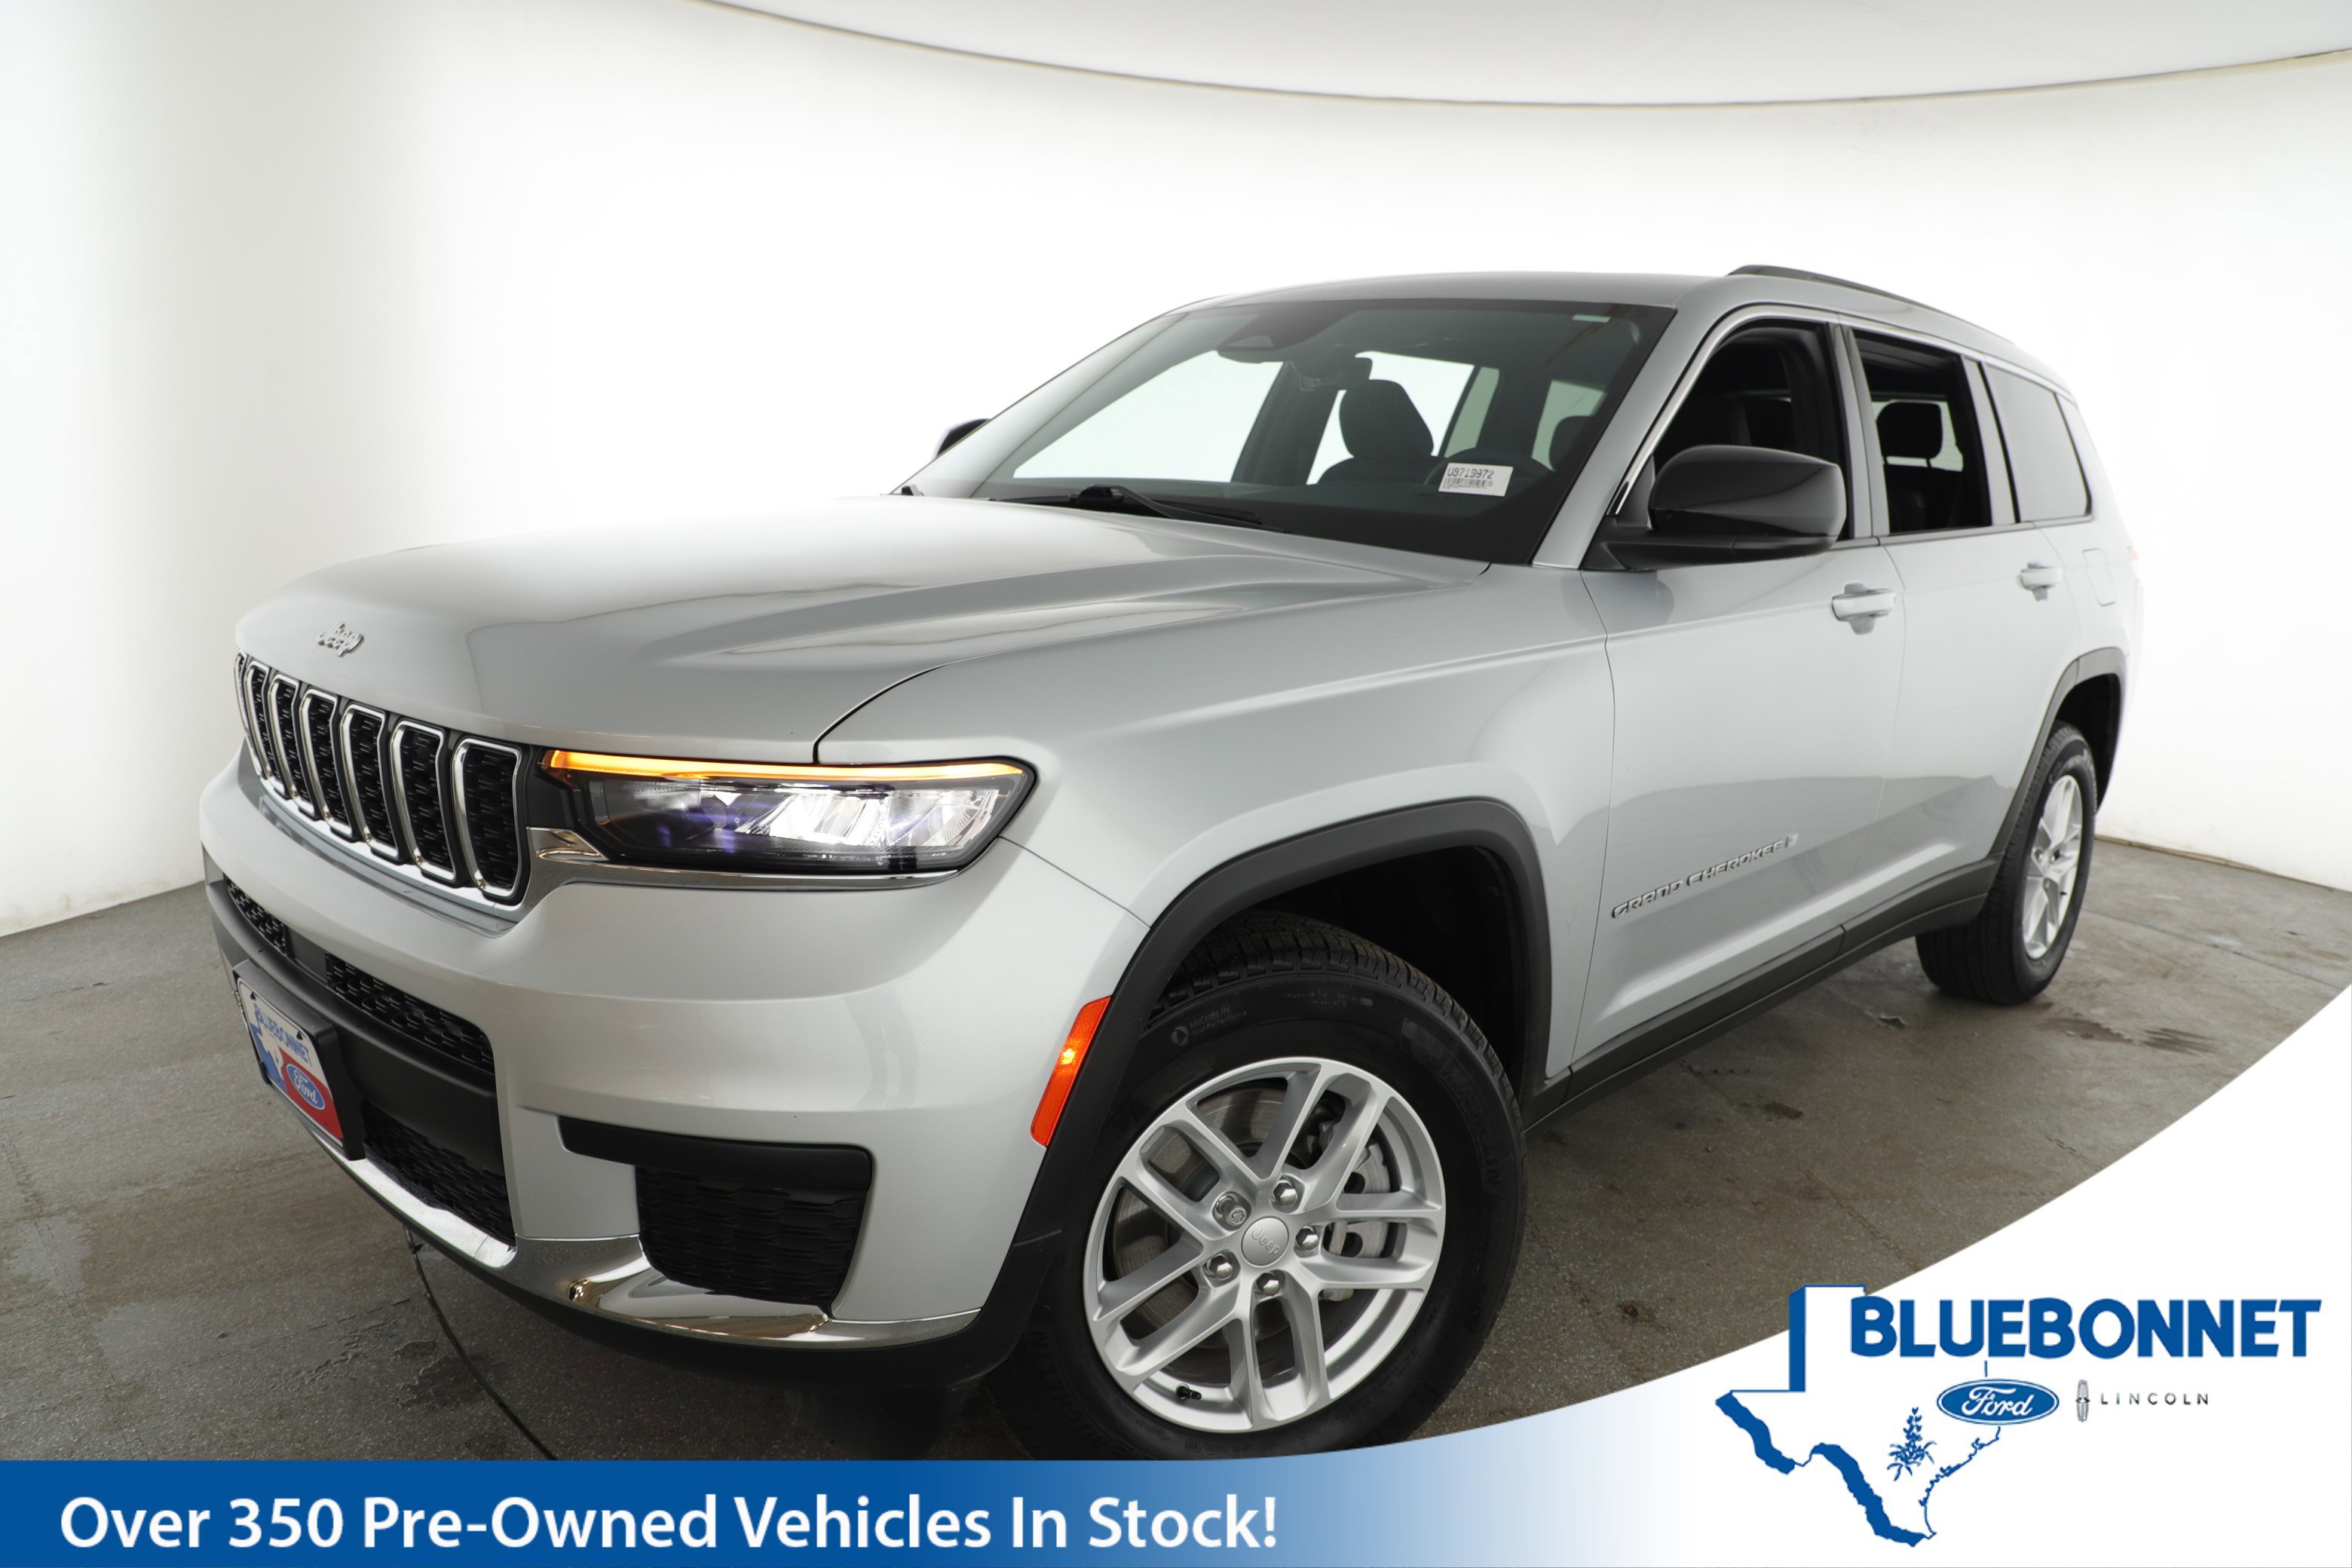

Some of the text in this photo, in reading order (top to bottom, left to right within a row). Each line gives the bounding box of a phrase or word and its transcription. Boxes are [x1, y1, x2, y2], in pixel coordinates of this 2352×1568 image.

[315, 620, 364, 658] Jeep
[1612, 839, 1784, 918] GRAND CHEROKEE
[253, 1003, 313, 1067] BLUEBONNET
[294, 1069, 318, 1105] Ford
[1251, 1228, 1280, 1255] Jeep
